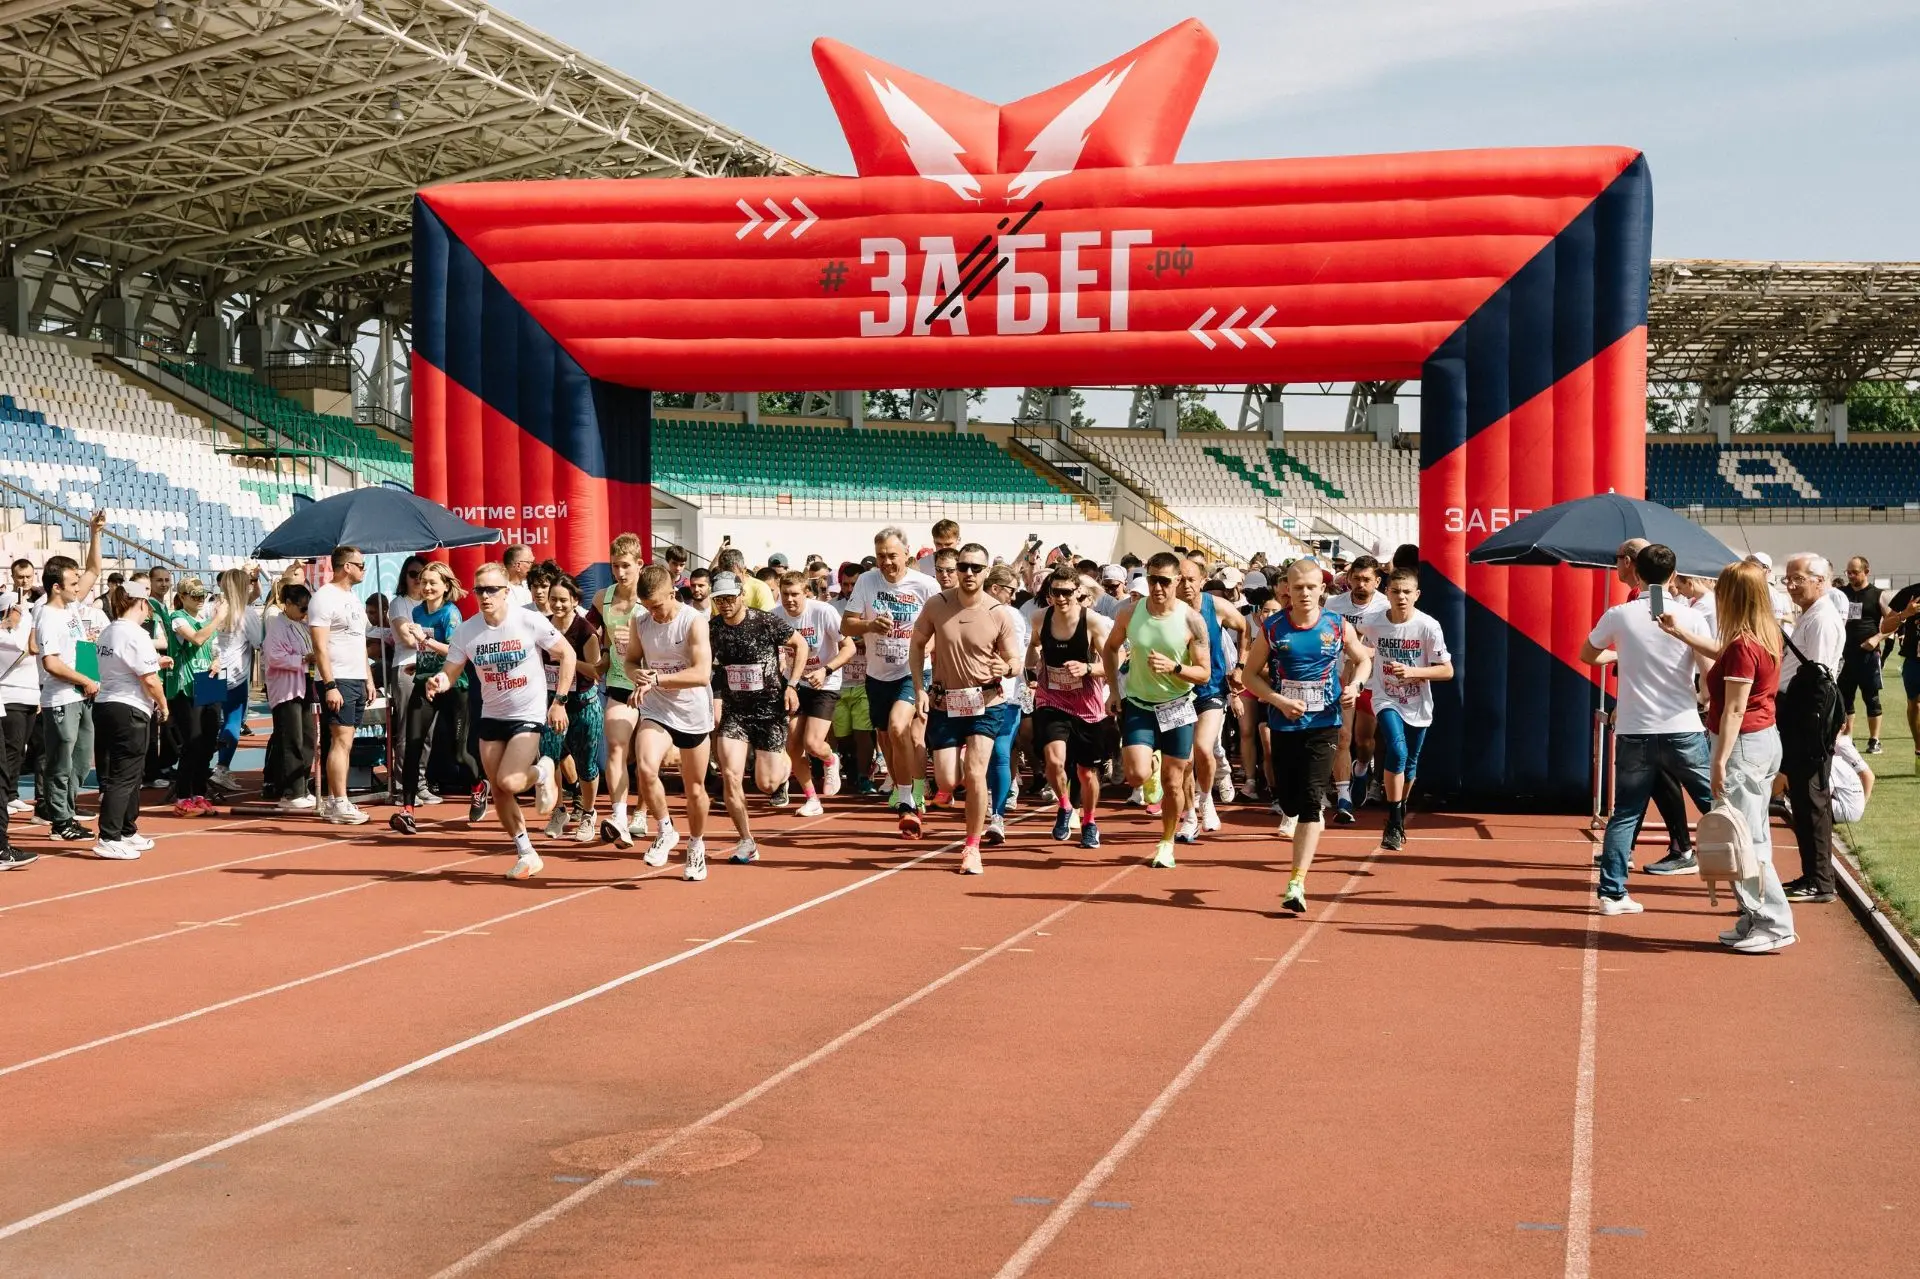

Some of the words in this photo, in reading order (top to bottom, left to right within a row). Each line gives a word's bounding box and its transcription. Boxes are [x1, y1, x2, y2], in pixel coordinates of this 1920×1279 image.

[523, 500, 568, 520] всей
[1445, 508, 1533, 532] ЗАБ
[476, 640, 521, 655] #ЗАБЕГ2025
[489, 650, 526, 664] ПЛАНЕТЫ
